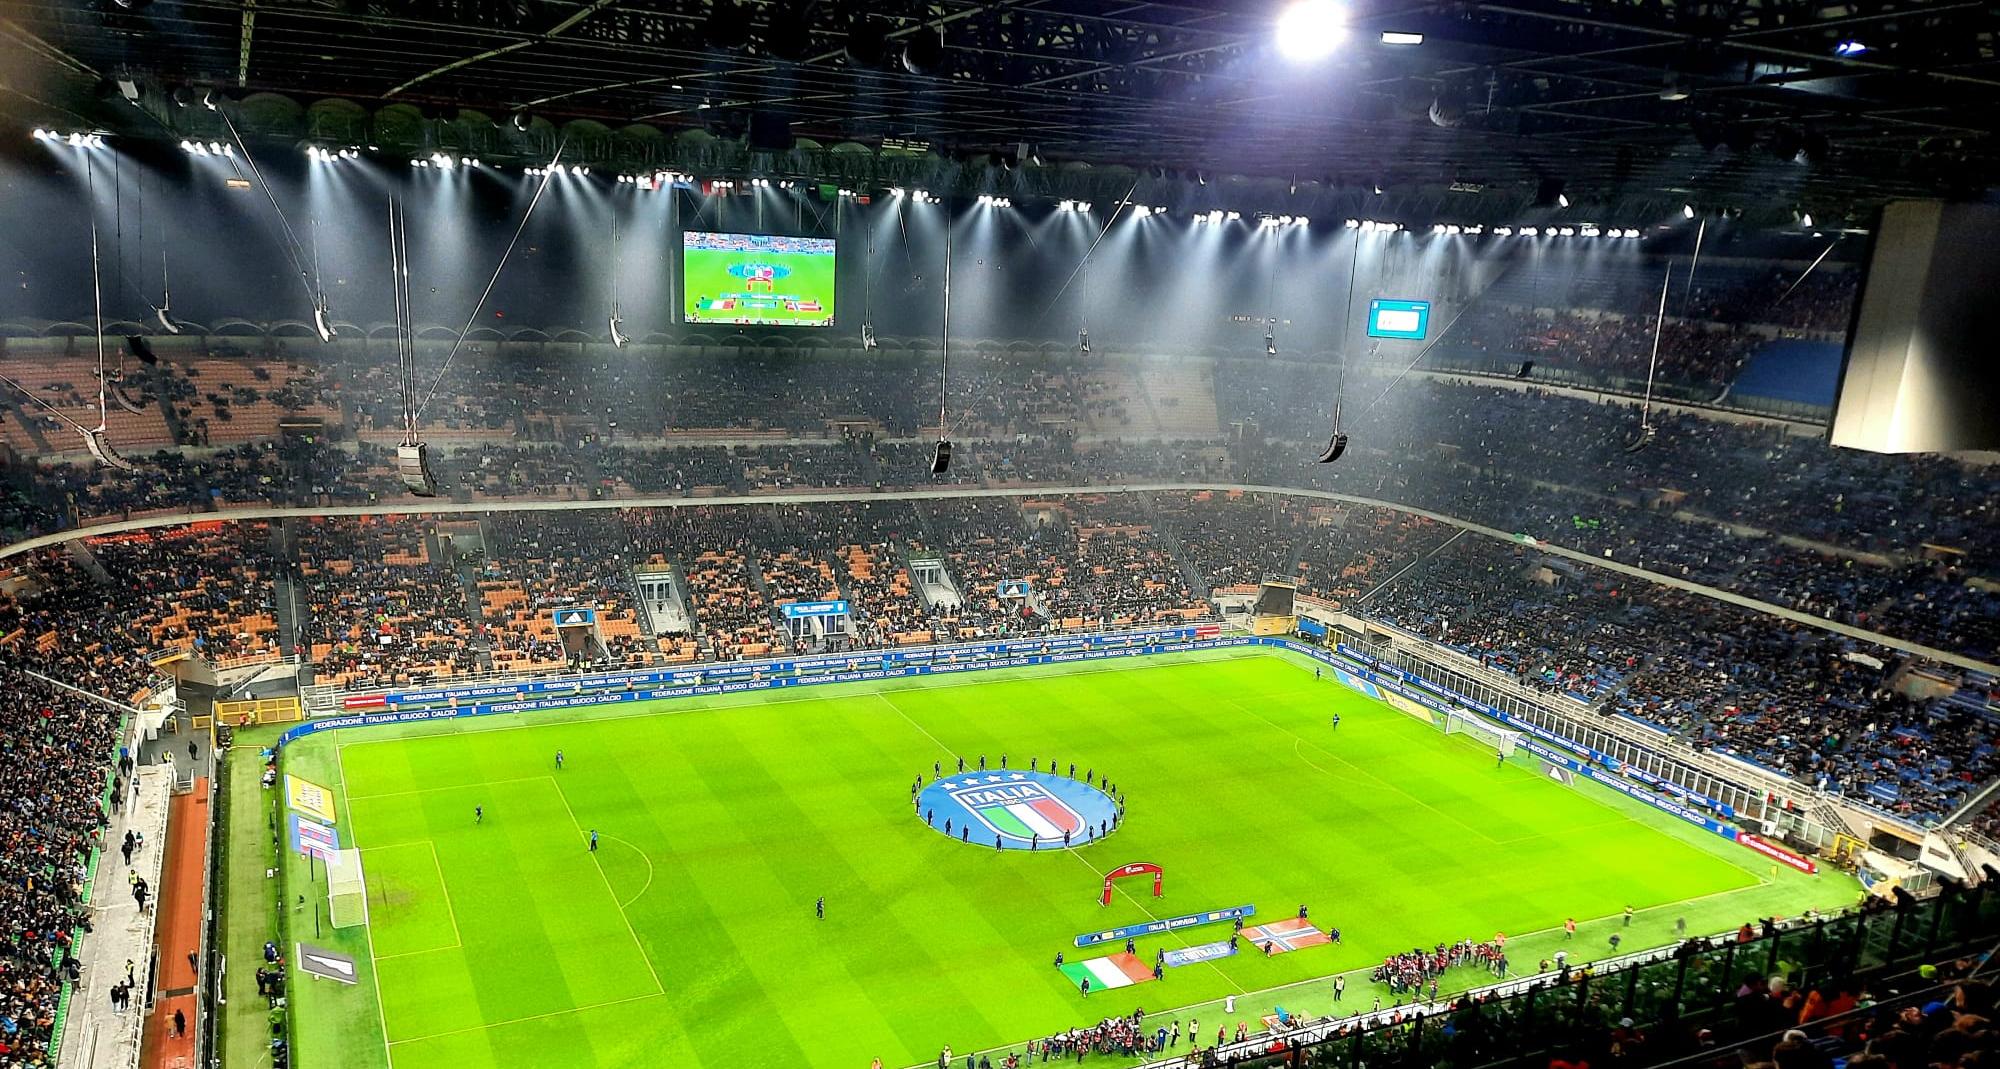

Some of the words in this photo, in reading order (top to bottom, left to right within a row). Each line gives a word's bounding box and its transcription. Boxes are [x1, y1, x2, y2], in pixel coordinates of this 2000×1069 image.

[403, 692, 444, 701] FEDERAZIONE
[445, 690, 470, 698] ITALIANA
[471, 688, 496, 696] GIUOCO
[651, 688, 694, 698] FEDERAZIONE
[694, 686, 721, 694] ITALIANA
[723, 683, 747, 691] GIUOCO
[748, 681, 771, 689] CALCIO
[490, 702, 537, 712] FEDERAZIONE
[539, 699, 568, 708] ITALIANA
[569, 697, 596, 705] GIUOCO
[598, 694, 621, 702] CALCIO
[313, 717, 364, 730] FEDERAZIONE
[365, 714, 398, 724] ITALIANA
[399, 711, 429, 721] GIUOCO
[431, 708, 458, 718] CALCIO
[1548, 751, 1568, 765] CALCIO
[961, 786, 1043, 805] ITALIA
[1681, 810, 1706, 825] CALCIO
[1148, 923, 1165, 932] ITALIA
